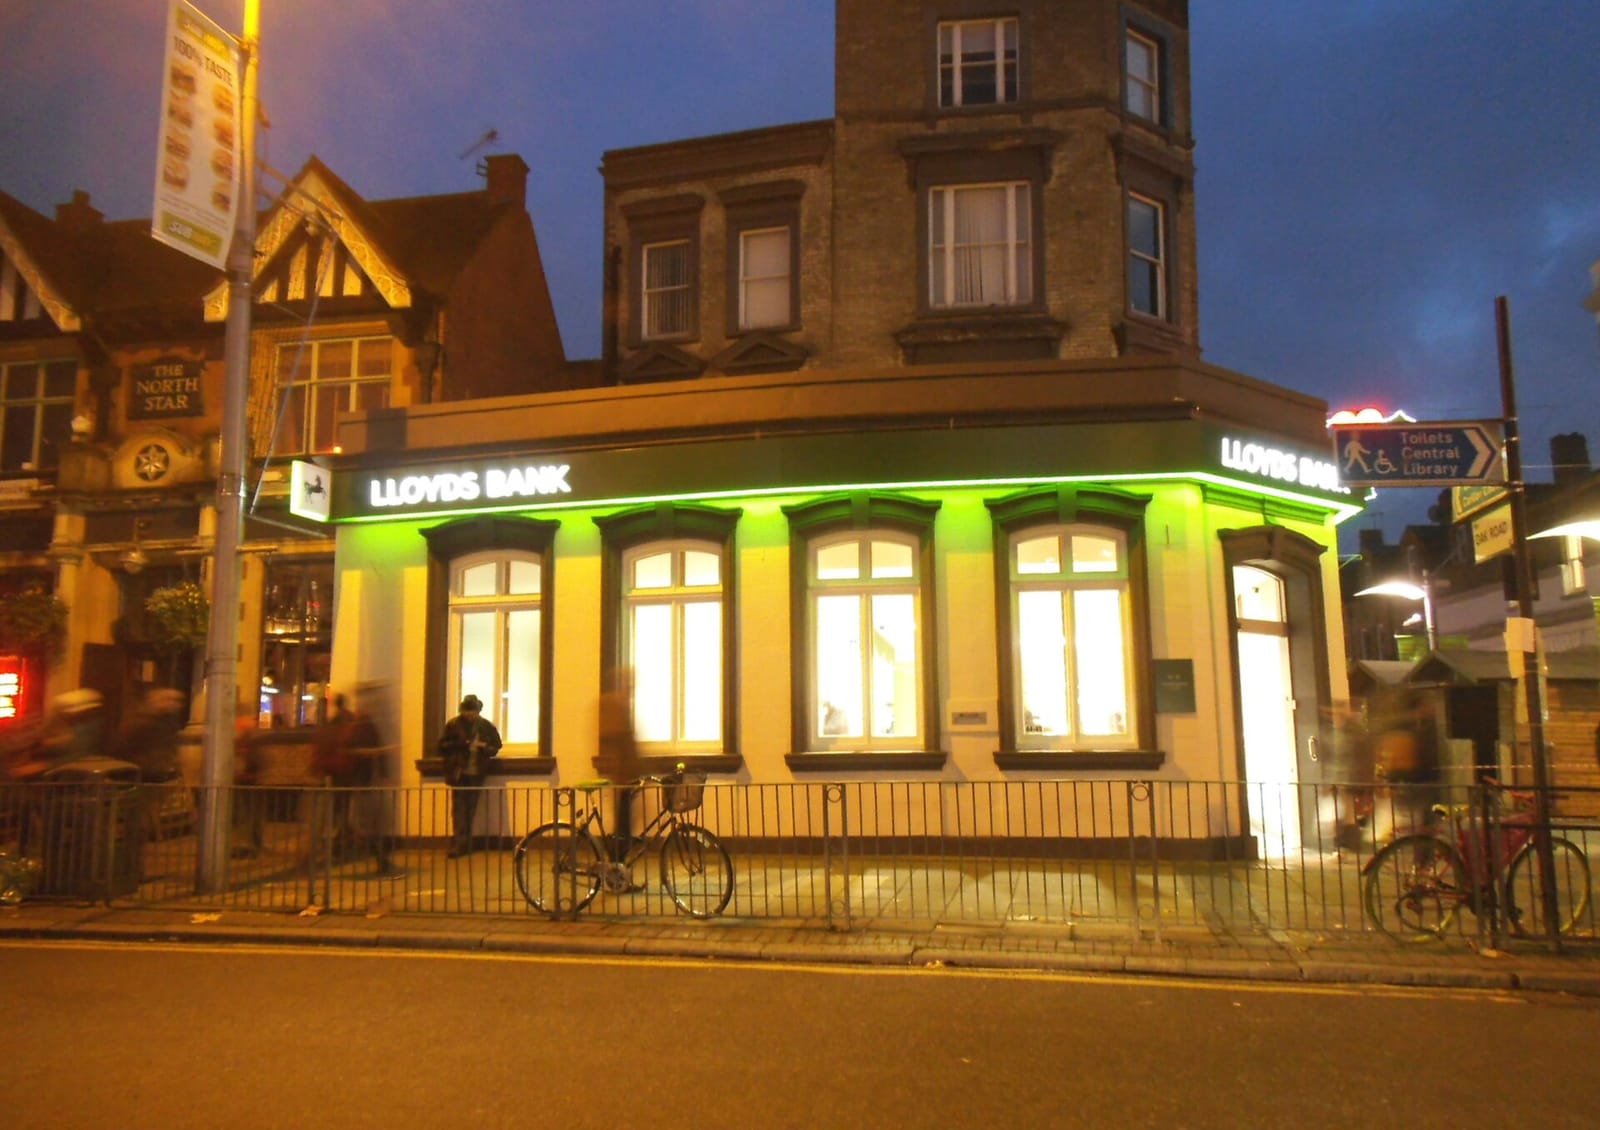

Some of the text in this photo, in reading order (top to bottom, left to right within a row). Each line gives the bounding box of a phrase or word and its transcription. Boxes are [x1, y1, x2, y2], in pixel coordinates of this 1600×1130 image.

[204, 55, 233, 88] TASTE
[152, 364, 184, 377] THE
[136, 377, 199, 394] NORTH
[143, 395, 189, 411] STAR
[1400, 431, 1454, 444] Toilets
[1221, 437, 1298, 482] LLOYDS
[1402, 446, 1460, 459] Central
[1403, 463, 1458, 478] Library
[370, 464, 572, 507] LLOYDS BANK
